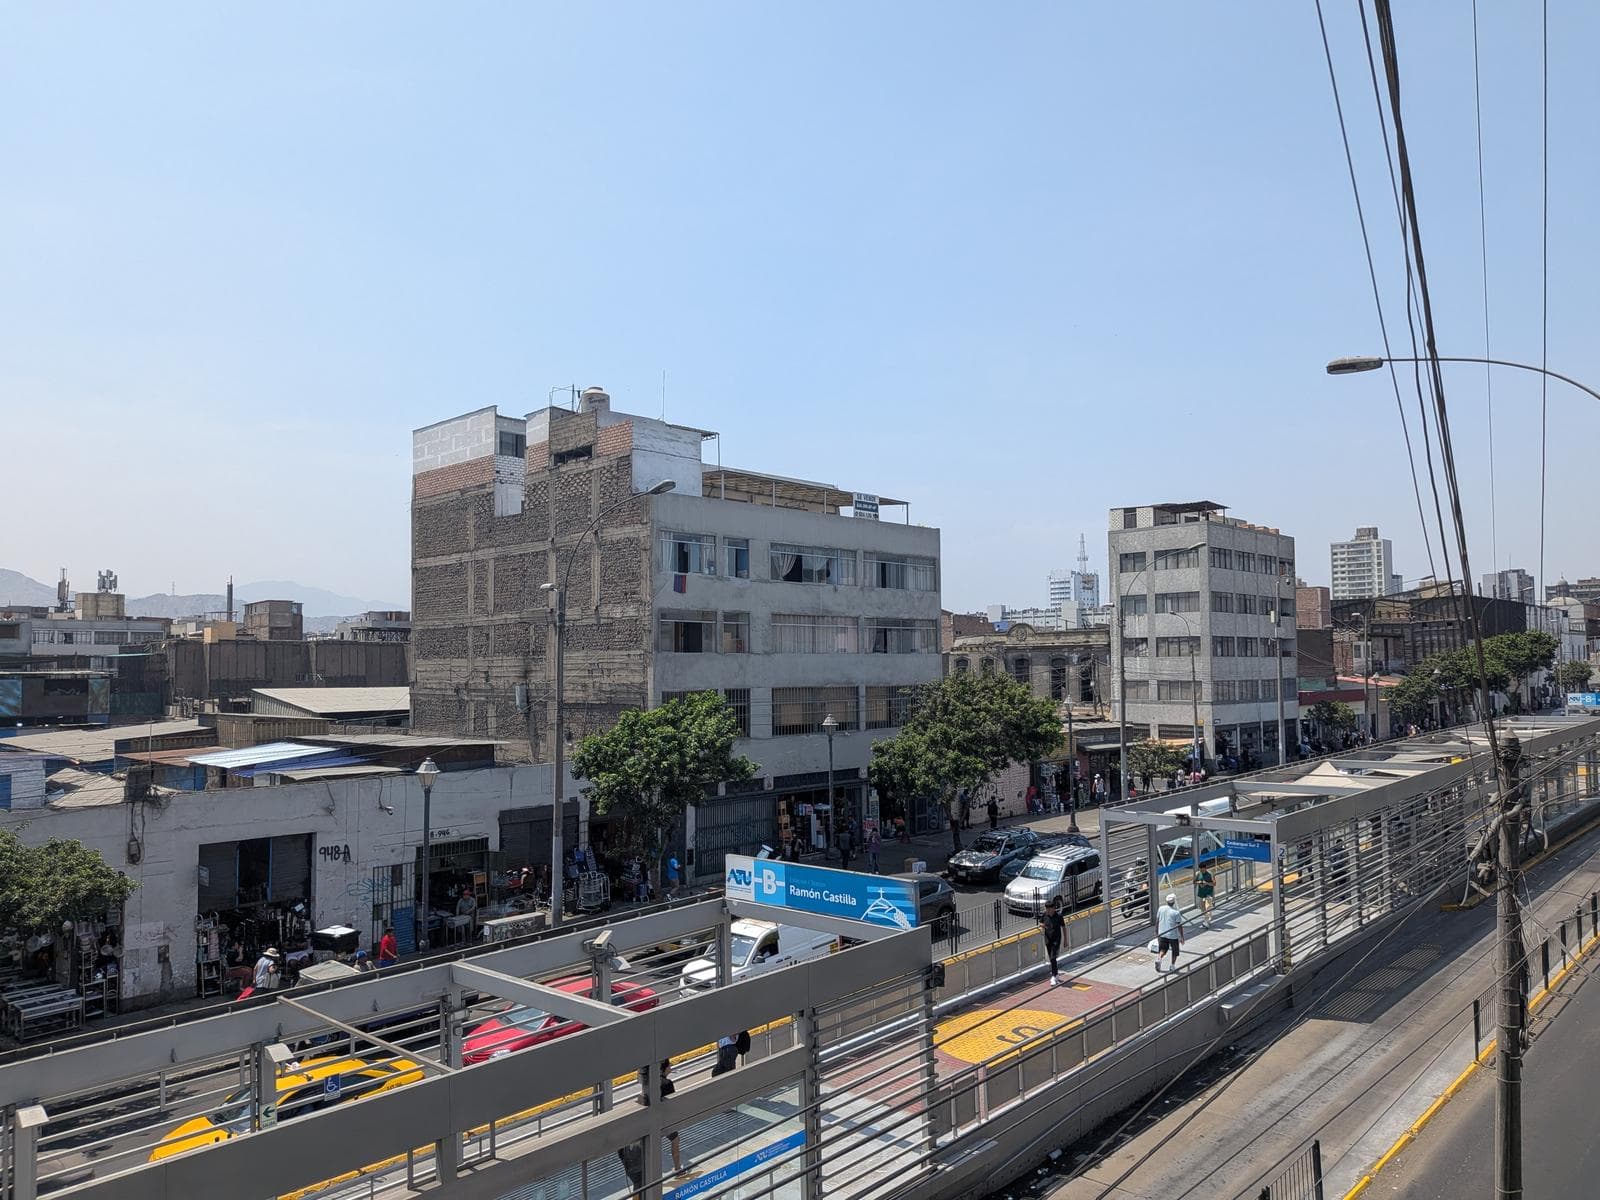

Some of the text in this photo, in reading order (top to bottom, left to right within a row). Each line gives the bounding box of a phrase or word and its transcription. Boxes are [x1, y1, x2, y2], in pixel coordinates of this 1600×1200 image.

[1280, 847, 1285, 857] 2
[727, 868, 752, 886] ATU
[762, 869, 777, 895] B
[789, 884, 857, 906] Ramón Castilla
[675, 1169, 727, 1199] RAMÓN CASTILLA
